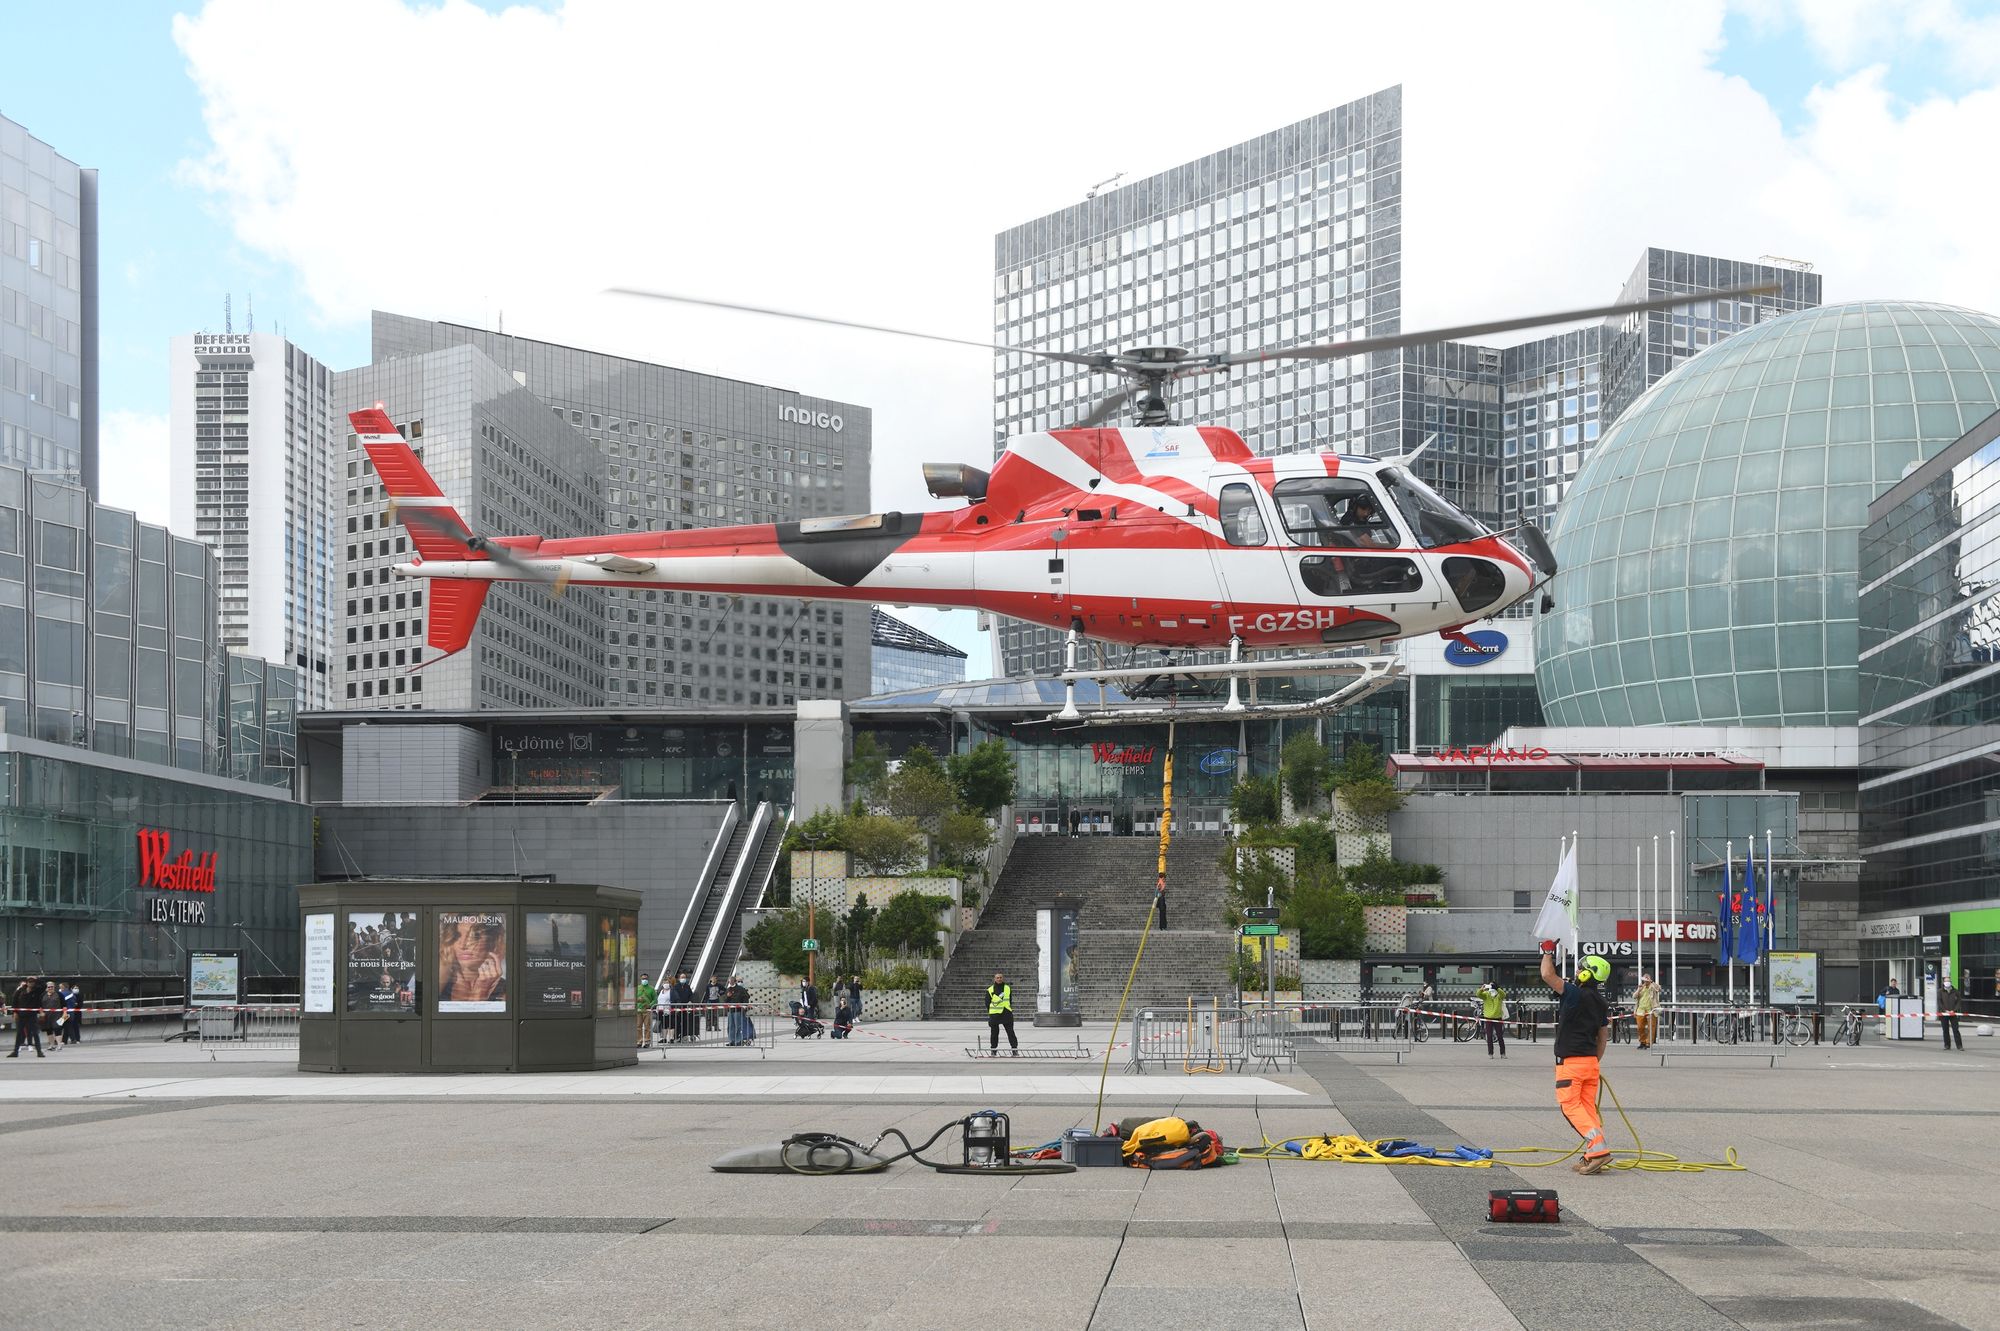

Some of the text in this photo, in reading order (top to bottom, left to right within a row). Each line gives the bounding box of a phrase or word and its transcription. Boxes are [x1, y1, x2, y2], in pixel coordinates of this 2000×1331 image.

[194, 334, 250, 345] DEFENSE
[194, 345, 251, 354] 2000
[1164, 444, 1180, 452] SAF
[1228, 609, 1335, 635] F-GZSH
[500, 735, 565, 750] le dôme
[1090, 742, 1154, 764] Westfield
[1435, 743, 1549, 764] VAPIANO
[1600, 751, 1641, 759] PASTA
[1659, 751, 1697, 759] PIZZA
[136, 827, 218, 894] Westfield
[151, 898, 206, 924] LES 4 TEMPS
[443, 915, 502, 924] MAUBOUSSIN
[1643, 923, 1717, 940] FIVE GUYS
[1582, 942, 1632, 955] GUYS
[381, 958, 400, 967] lisez
[400, 961, 416, 970] pas.
[553, 959, 571, 967] lisez
[570, 961, 586, 970] pas.
